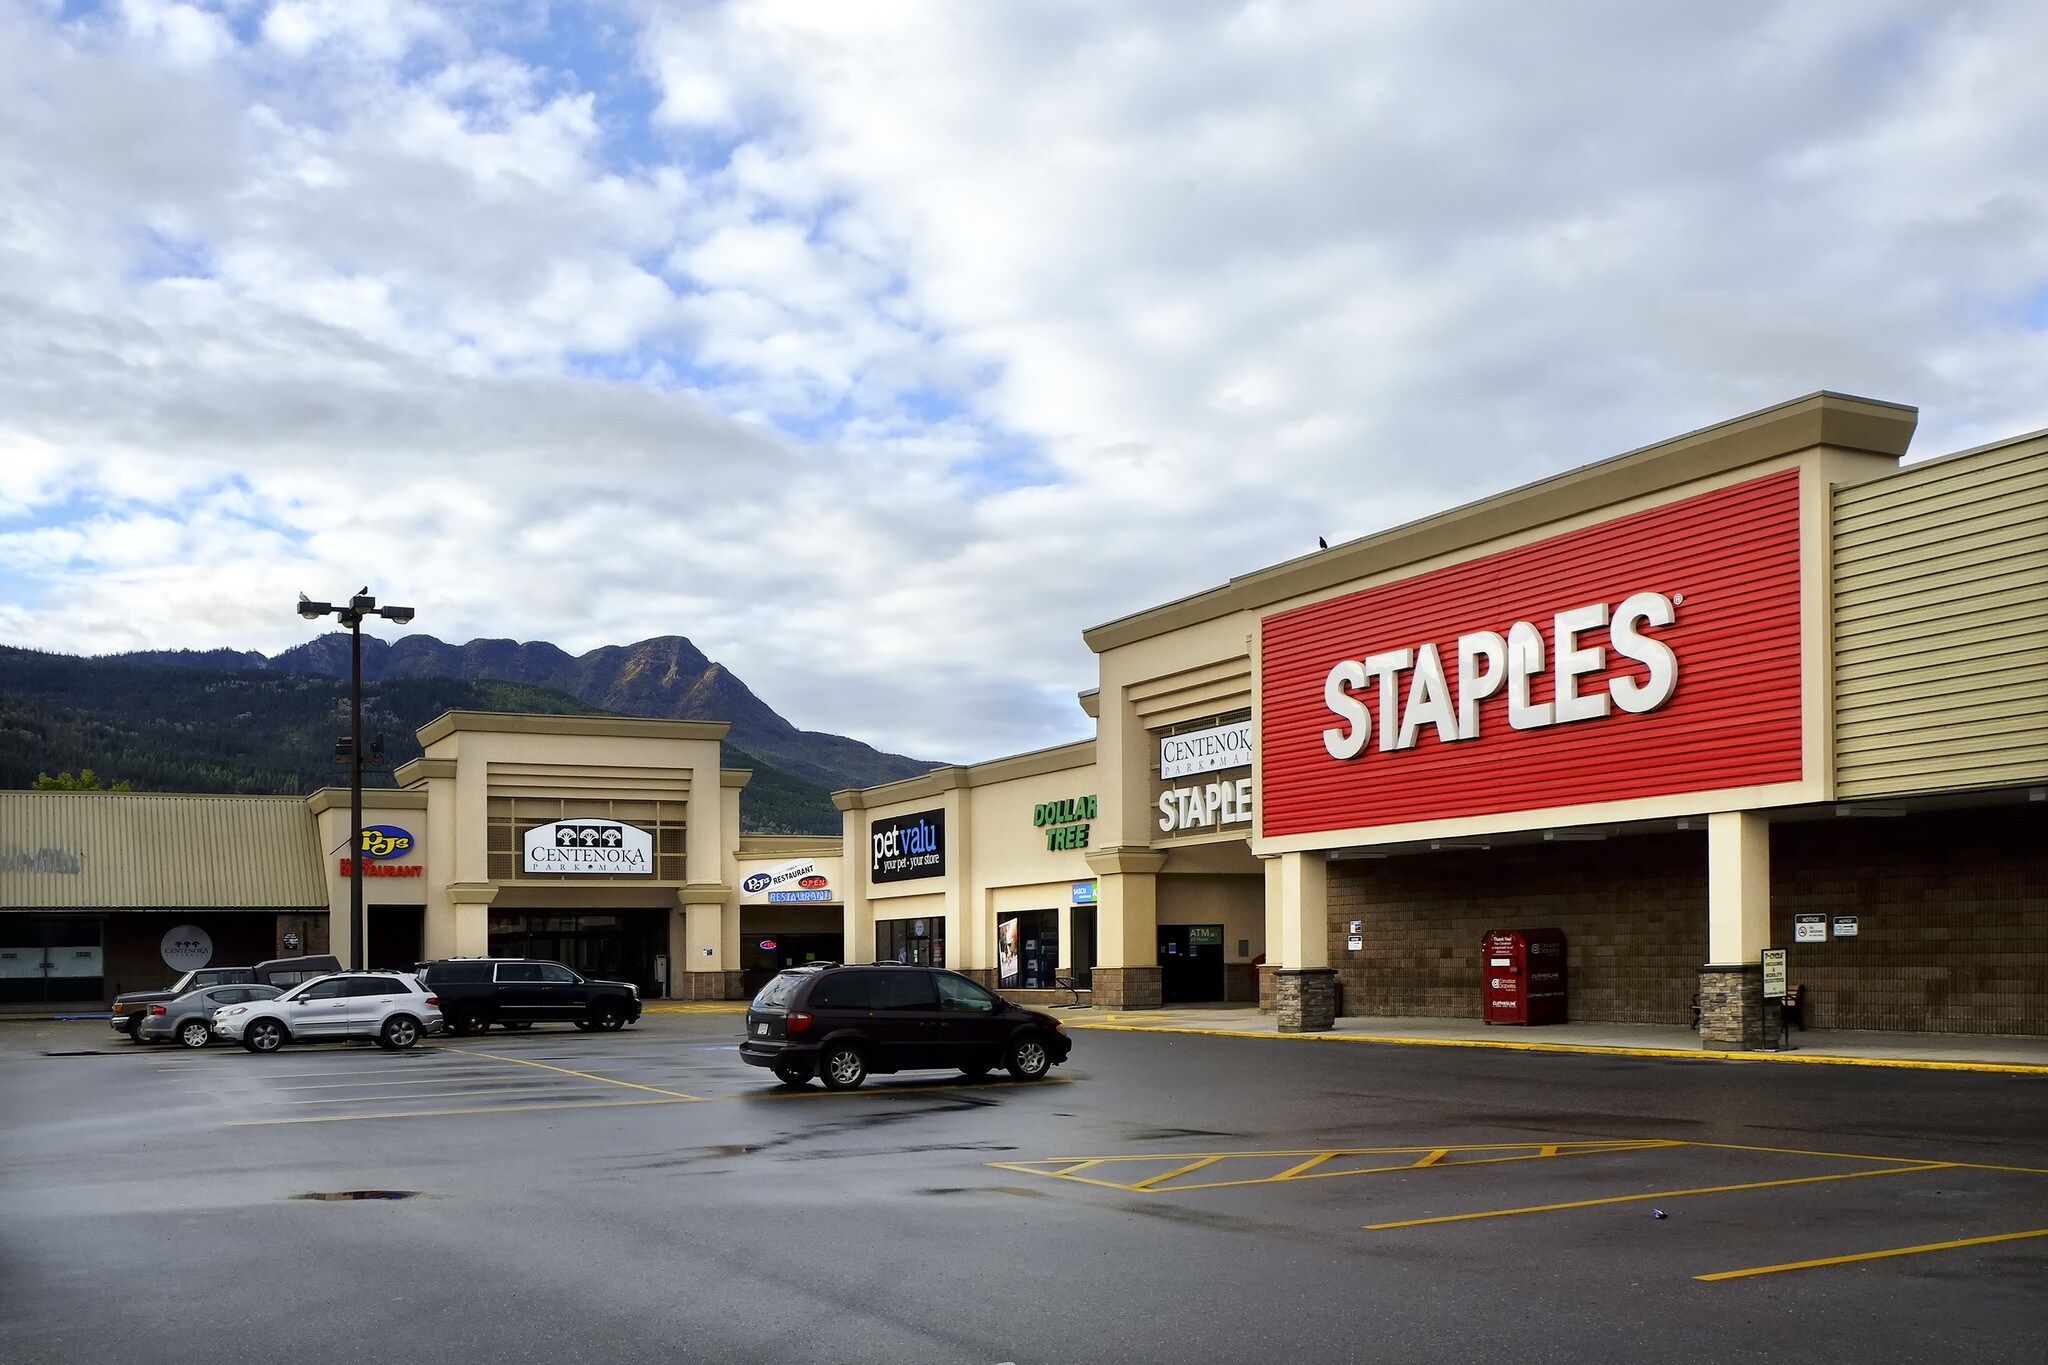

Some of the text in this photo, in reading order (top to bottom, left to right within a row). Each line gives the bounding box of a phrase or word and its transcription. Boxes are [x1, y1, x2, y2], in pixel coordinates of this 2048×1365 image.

[1323, 592, 1679, 760] STAPLES
[1163, 728, 1252, 763] CENTENOK
[1165, 752, 1252, 776] PARK MAL
[1033, 794, 1098, 827] DOLLAR
[1159, 777, 1253, 832] STAPLE
[873, 819, 937, 870] pet valu
[1045, 824, 1089, 851] TREE
[531, 847, 645, 865] CENTENOKA
[883, 854, 940, 874] your pet your store
[340, 866, 423, 877] RTAURANT
[773, 865, 814, 885] RESTAURANT
[801, 879, 825, 887] OPEN
[770, 890, 831, 902] RESTAURANT
[1190, 928, 1210, 937] ATM
[165, 946, 209, 955] CENTENOKA
